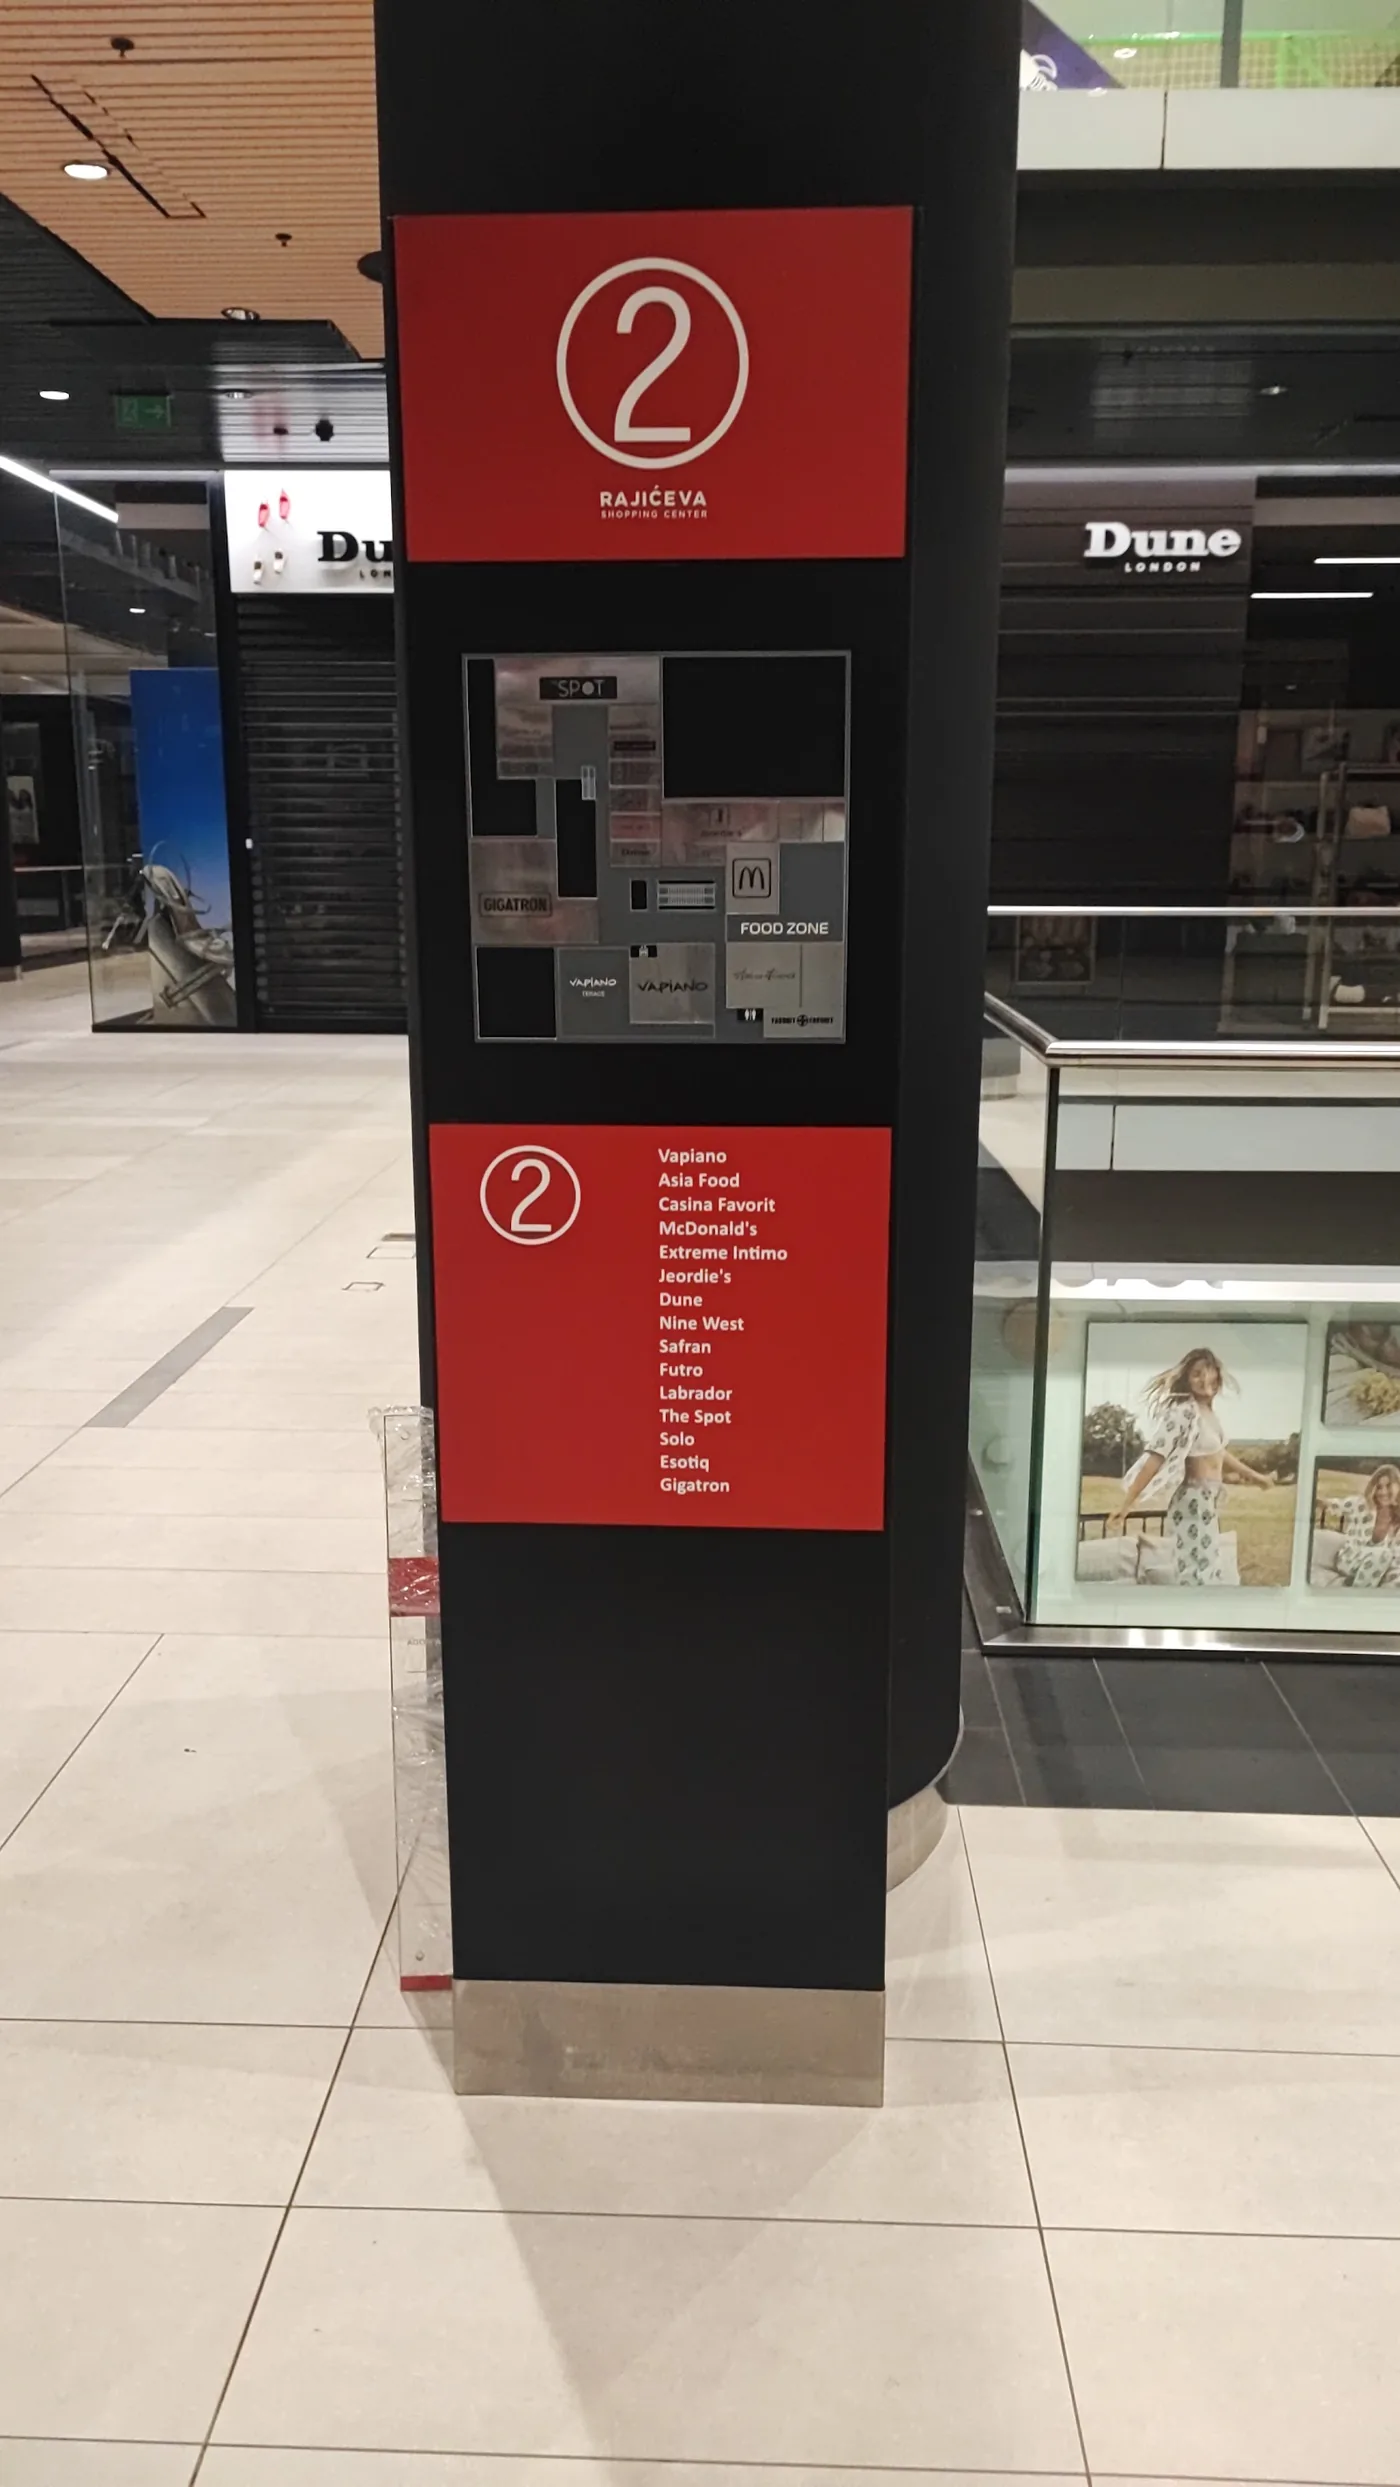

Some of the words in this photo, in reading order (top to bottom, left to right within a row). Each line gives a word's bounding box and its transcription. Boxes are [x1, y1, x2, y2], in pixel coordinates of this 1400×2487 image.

[614, 286, 691, 442] 2
[600, 484, 707, 507] RAJIĆEVA
[601, 509, 658, 519] SHOPPING
[664, 509, 707, 518] CENTER
[317, 531, 393, 563] Du
[1084, 521, 1242, 558] Dune
[1124, 561, 1201, 573] LONDON
[483, 897, 547, 912] GIGATRON
[740, 922, 784, 935] FOOD
[786, 922, 829, 935] ZONE
[658, 1148, 727, 1167] Vapiano
[659, 1172, 694, 1188] Asia
[699, 1172, 740, 1188] Food
[510, 1158, 552, 1232] 2
[659, 1196, 713, 1212] Casina
[719, 1197, 776, 1213] Favorit
[660, 1220, 758, 1237] McDonald's
[660, 1244, 729, 1260] Extreme
[734, 1245, 788, 1261] Intimo
[659, 1268, 732, 1284] Jeordie's
[660, 1292, 703, 1307] Dune
[660, 1315, 698, 1331] Nine
[703, 1316, 745, 1332] West
[660, 1338, 712, 1354] Safran
[660, 1362, 704, 1378] Futro
[660, 1384, 733, 1401] Labrador
[659, 1407, 690, 1424] The
[695, 1409, 732, 1427] Spot
[660, 1431, 695, 1447] Solo
[661, 1454, 710, 1473] Esotiq
[660, 1477, 730, 1495] Gigatron
